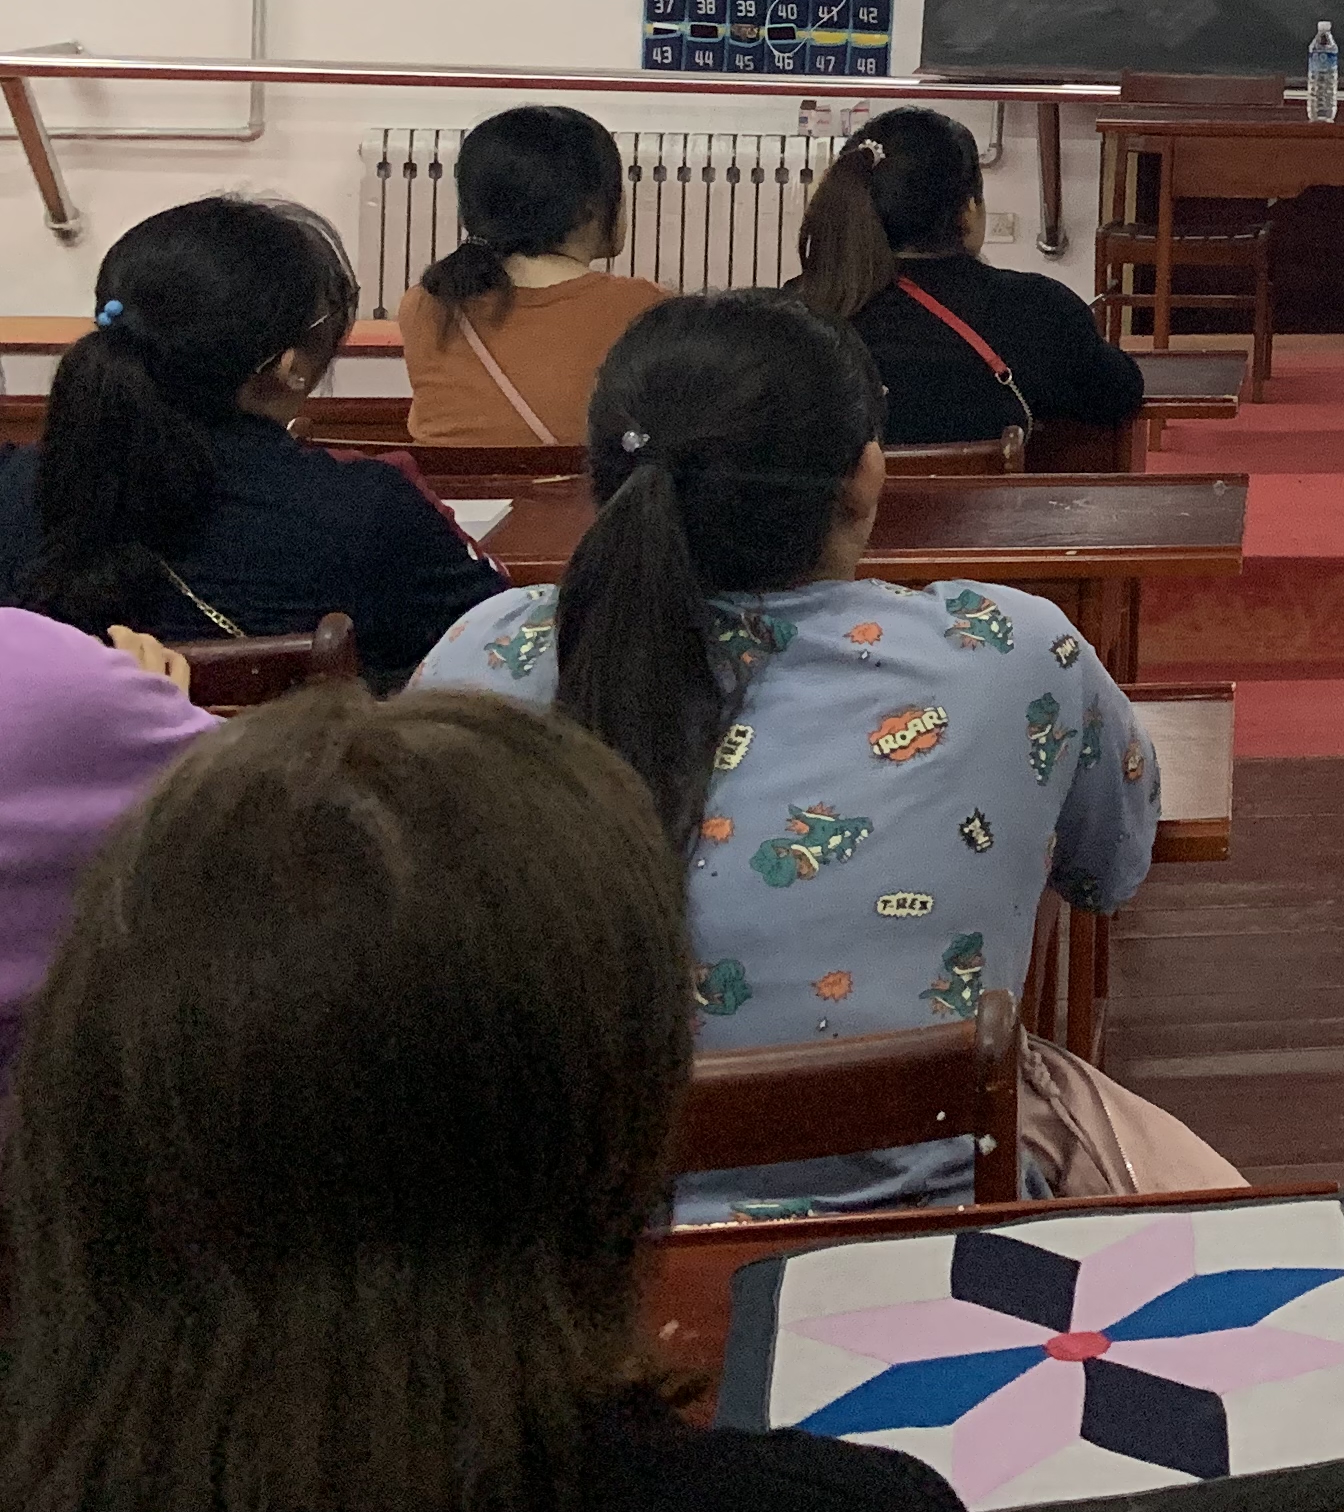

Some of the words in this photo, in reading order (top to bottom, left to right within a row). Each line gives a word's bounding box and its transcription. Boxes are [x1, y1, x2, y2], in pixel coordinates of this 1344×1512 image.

[736, 0, 756, 17] 39
[777, 3, 798, 20] 40
[858, 6, 878, 24] 42
[652, 46, 673, 64] 43
[694, 50, 714, 68] 44
[735, 53, 754, 71] 45
[774, 53, 794, 70] 46
[815, 55, 836, 73] 47
[856, 57, 876, 75] 48
